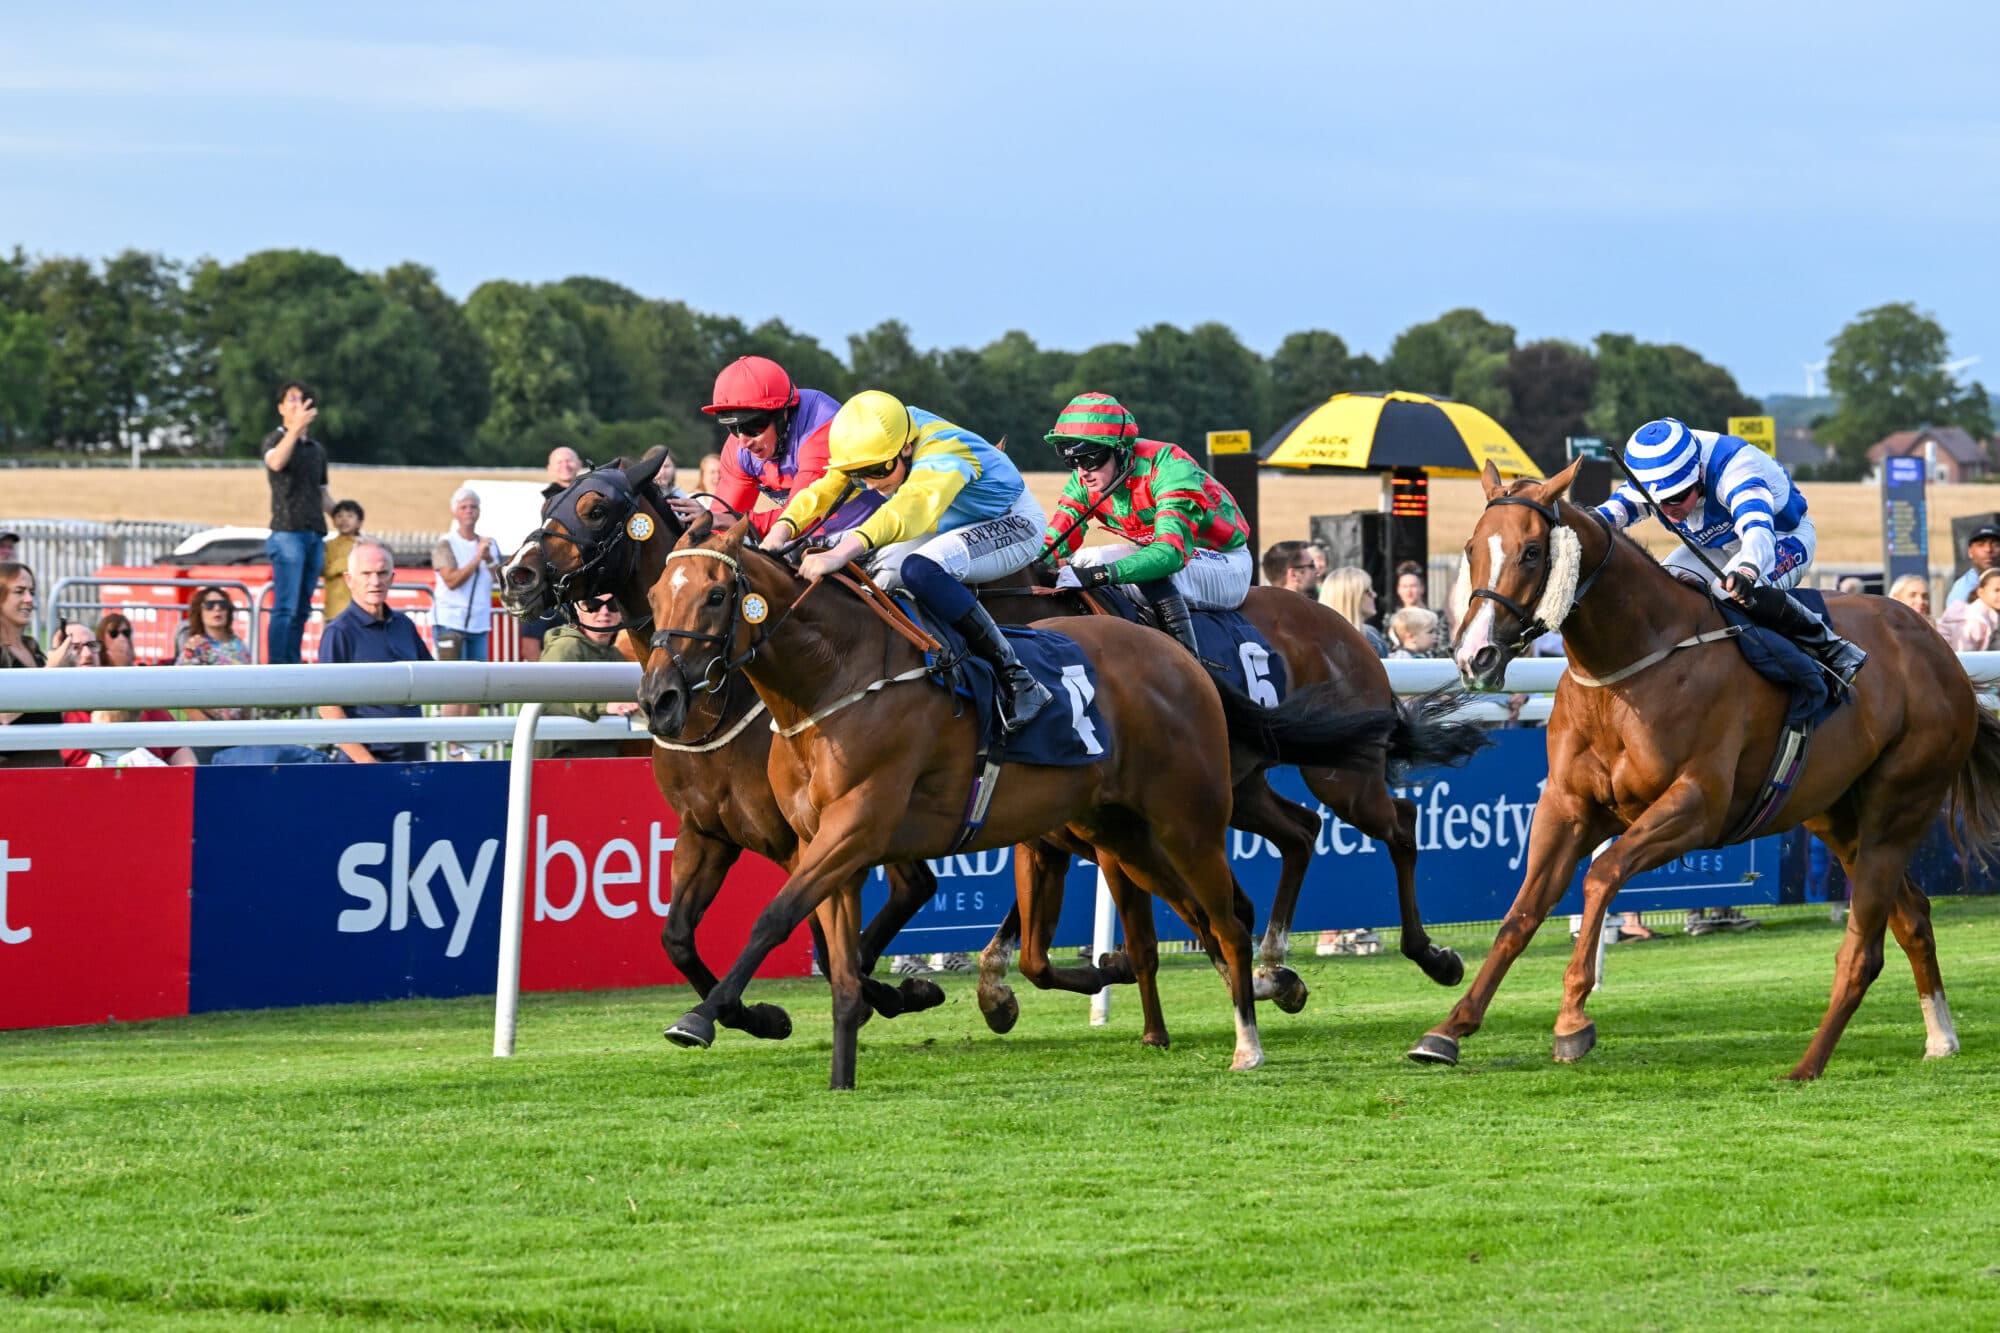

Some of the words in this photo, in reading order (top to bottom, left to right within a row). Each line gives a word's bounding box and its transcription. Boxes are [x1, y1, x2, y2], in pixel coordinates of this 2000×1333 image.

[1306, 436, 1352, 445] JACK
[1294, 449, 1349, 459] JONES
[993, 535, 1012, 550] LTD
[1061, 664, 1104, 755] 4
[337, 811, 499, 958] sky
[534, 814, 677, 921] bet
